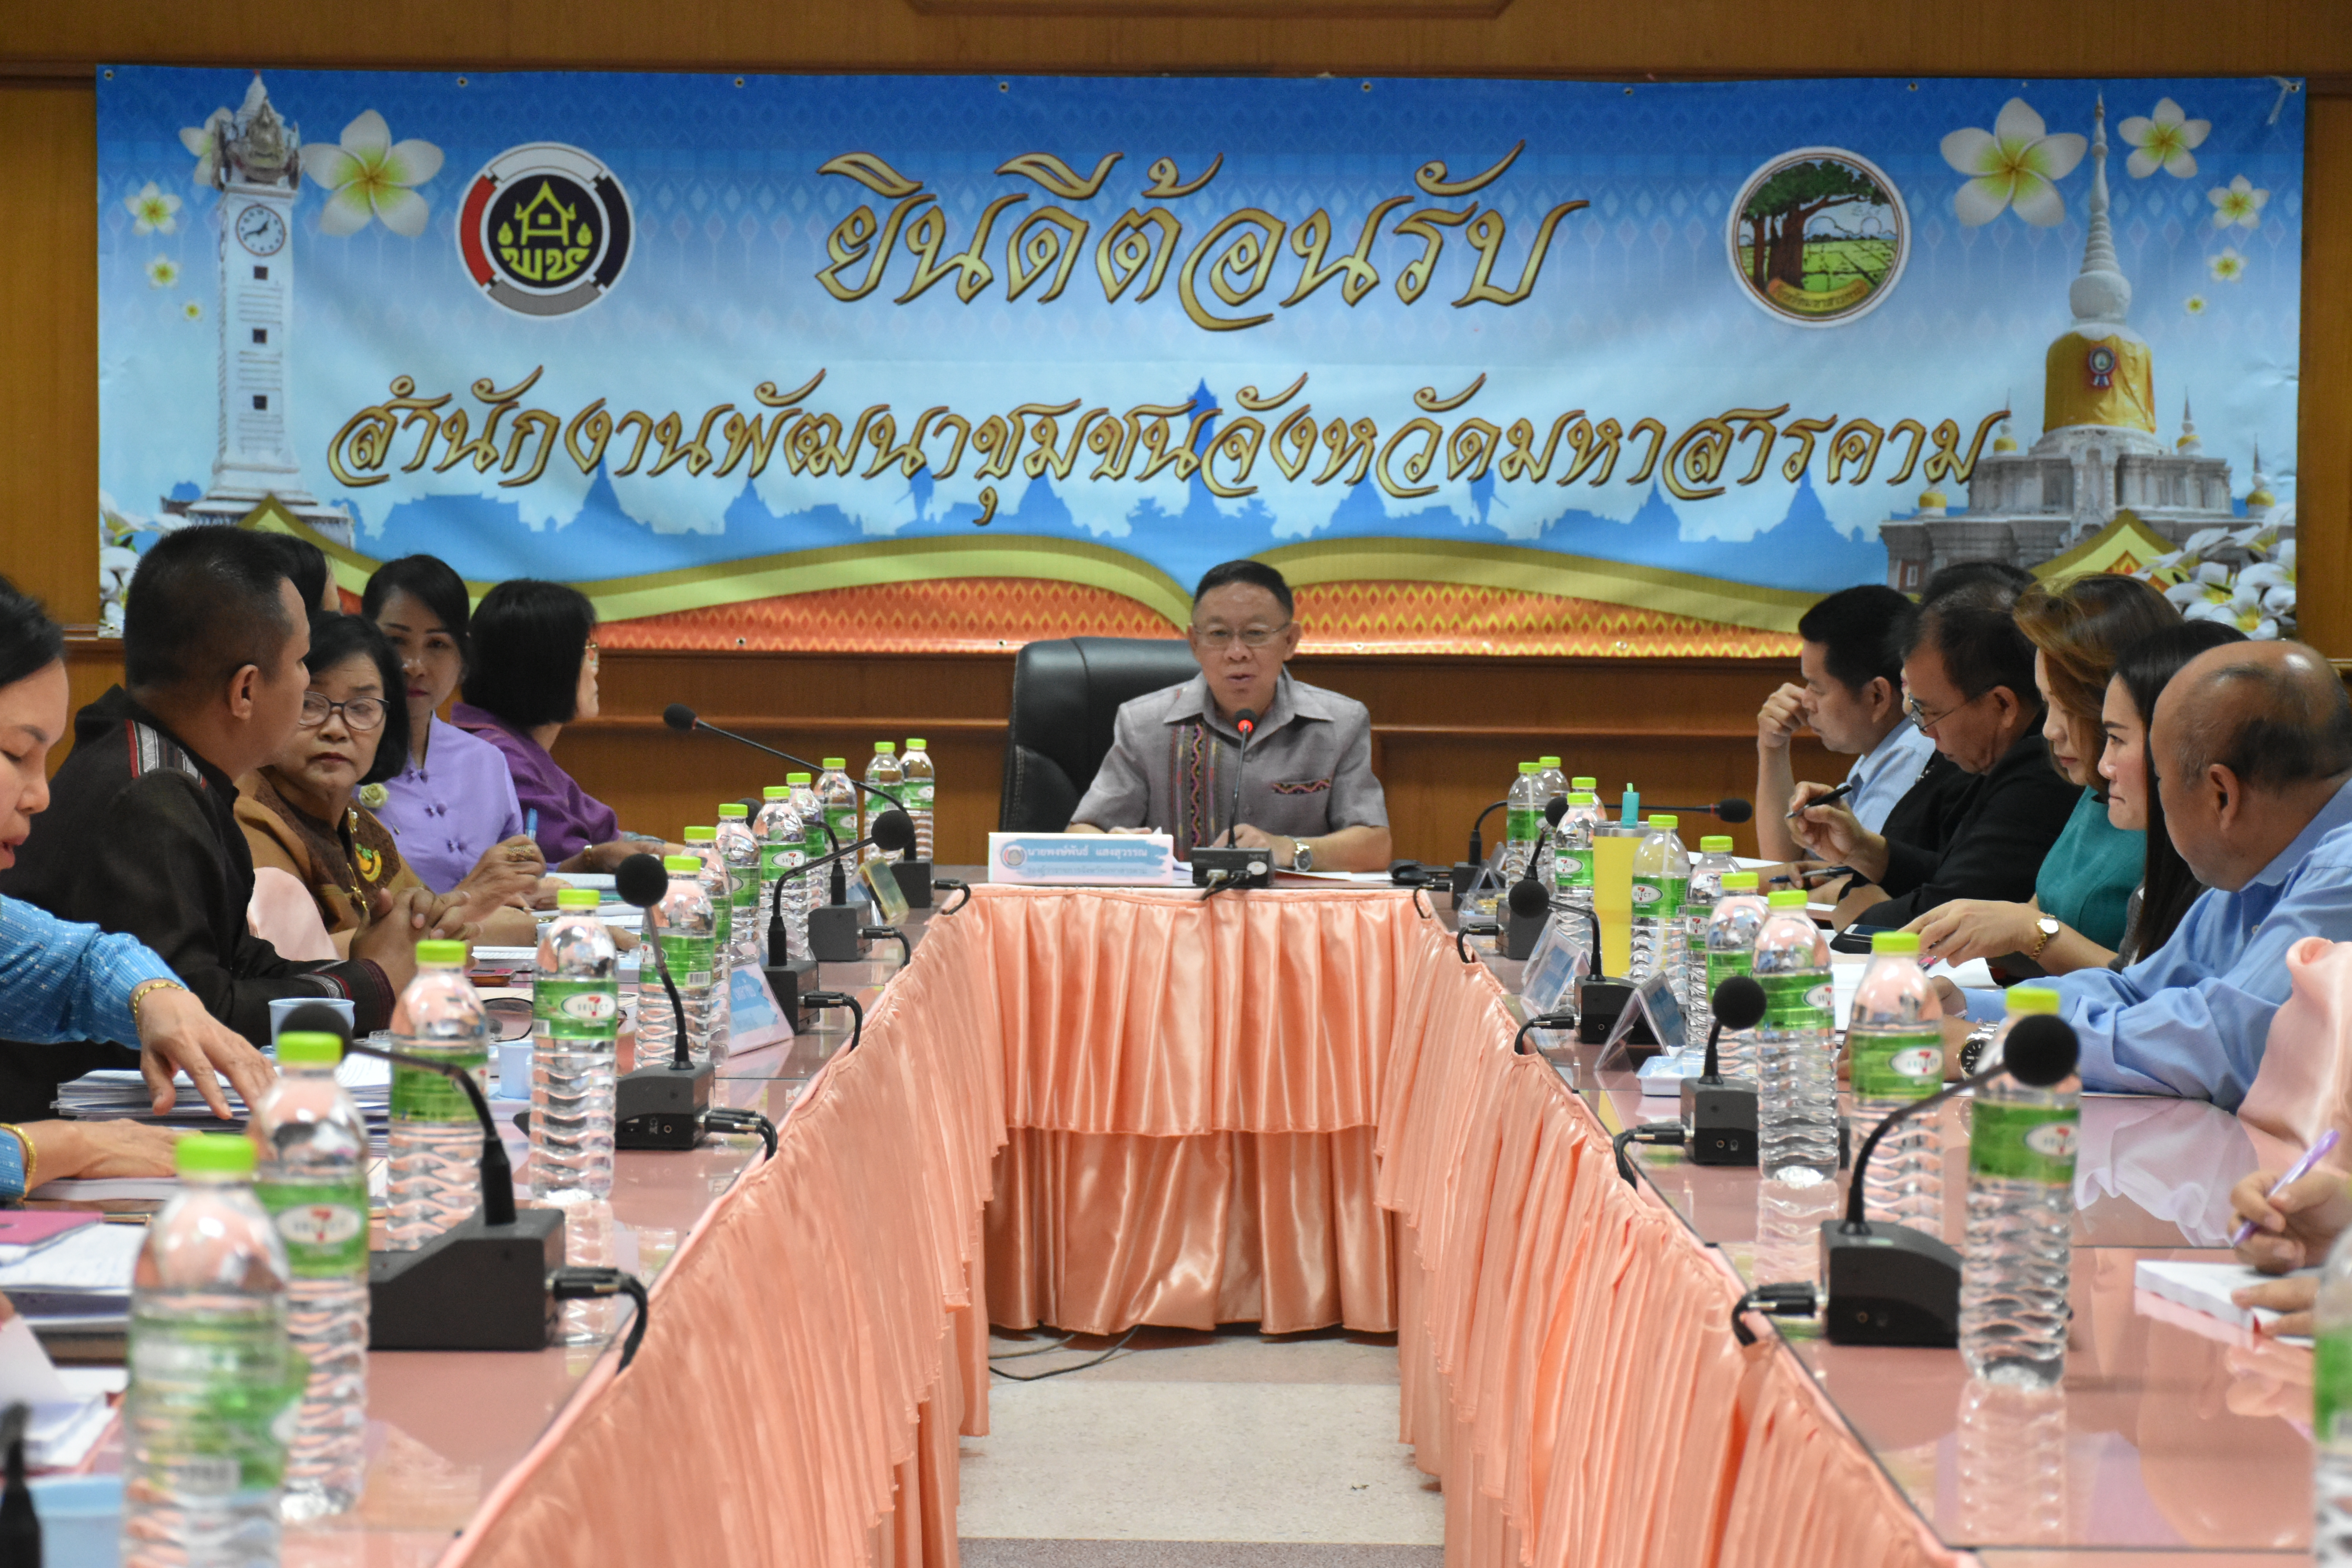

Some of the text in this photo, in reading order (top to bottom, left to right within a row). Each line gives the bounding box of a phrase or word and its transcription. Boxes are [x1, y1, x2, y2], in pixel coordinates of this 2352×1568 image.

[815, 139, 1589, 331] ยินดีต้อนรับ
[327, 365, 2011, 526] สำนักงานพัฒนาชุมชนจังหวัดมหาสารคาม
